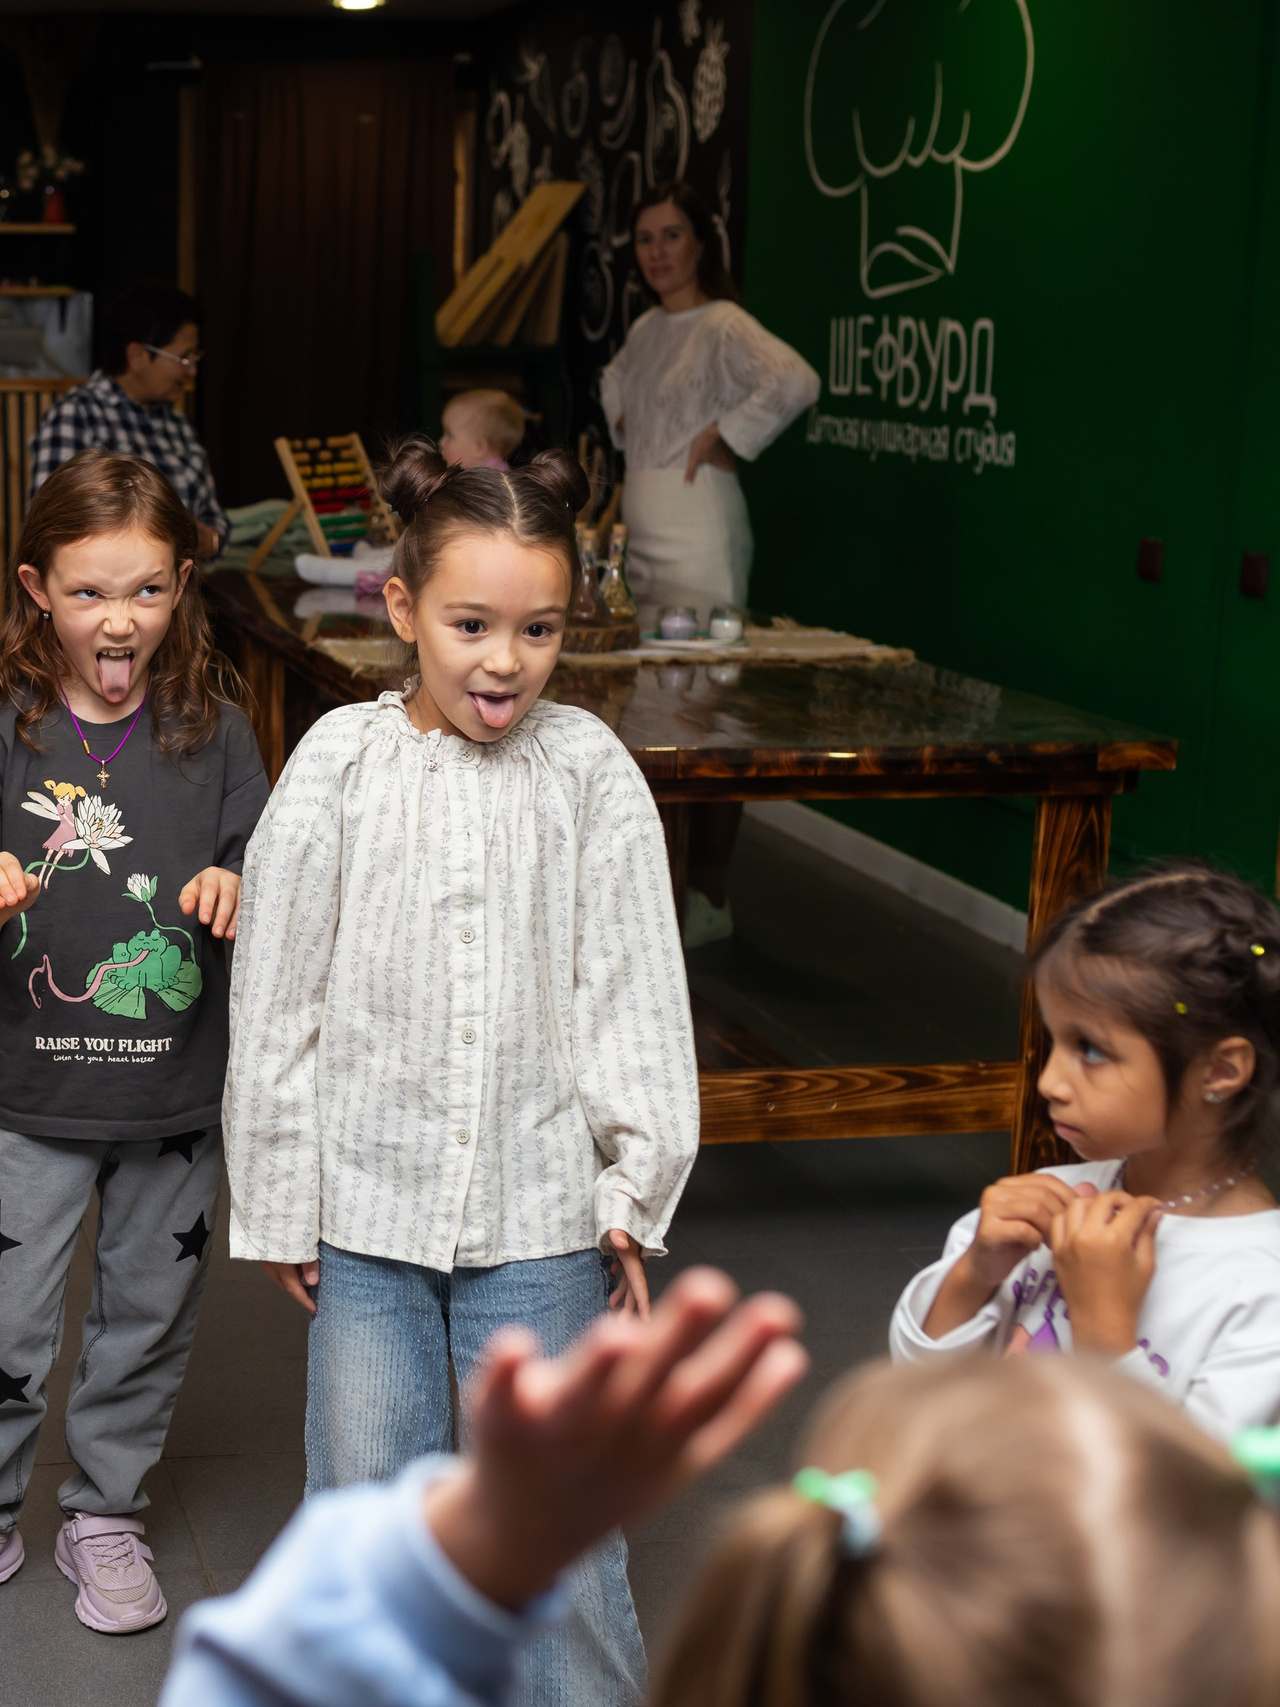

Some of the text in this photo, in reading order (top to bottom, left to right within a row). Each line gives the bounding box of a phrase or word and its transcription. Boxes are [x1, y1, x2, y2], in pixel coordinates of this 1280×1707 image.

[828, 314, 998, 418] ШЕФВУРД
[35, 1036, 173, 1053] RAISE YOU FLIGHT
[74, 1053, 85, 1061] to
[107, 1055, 130, 1063] heart
